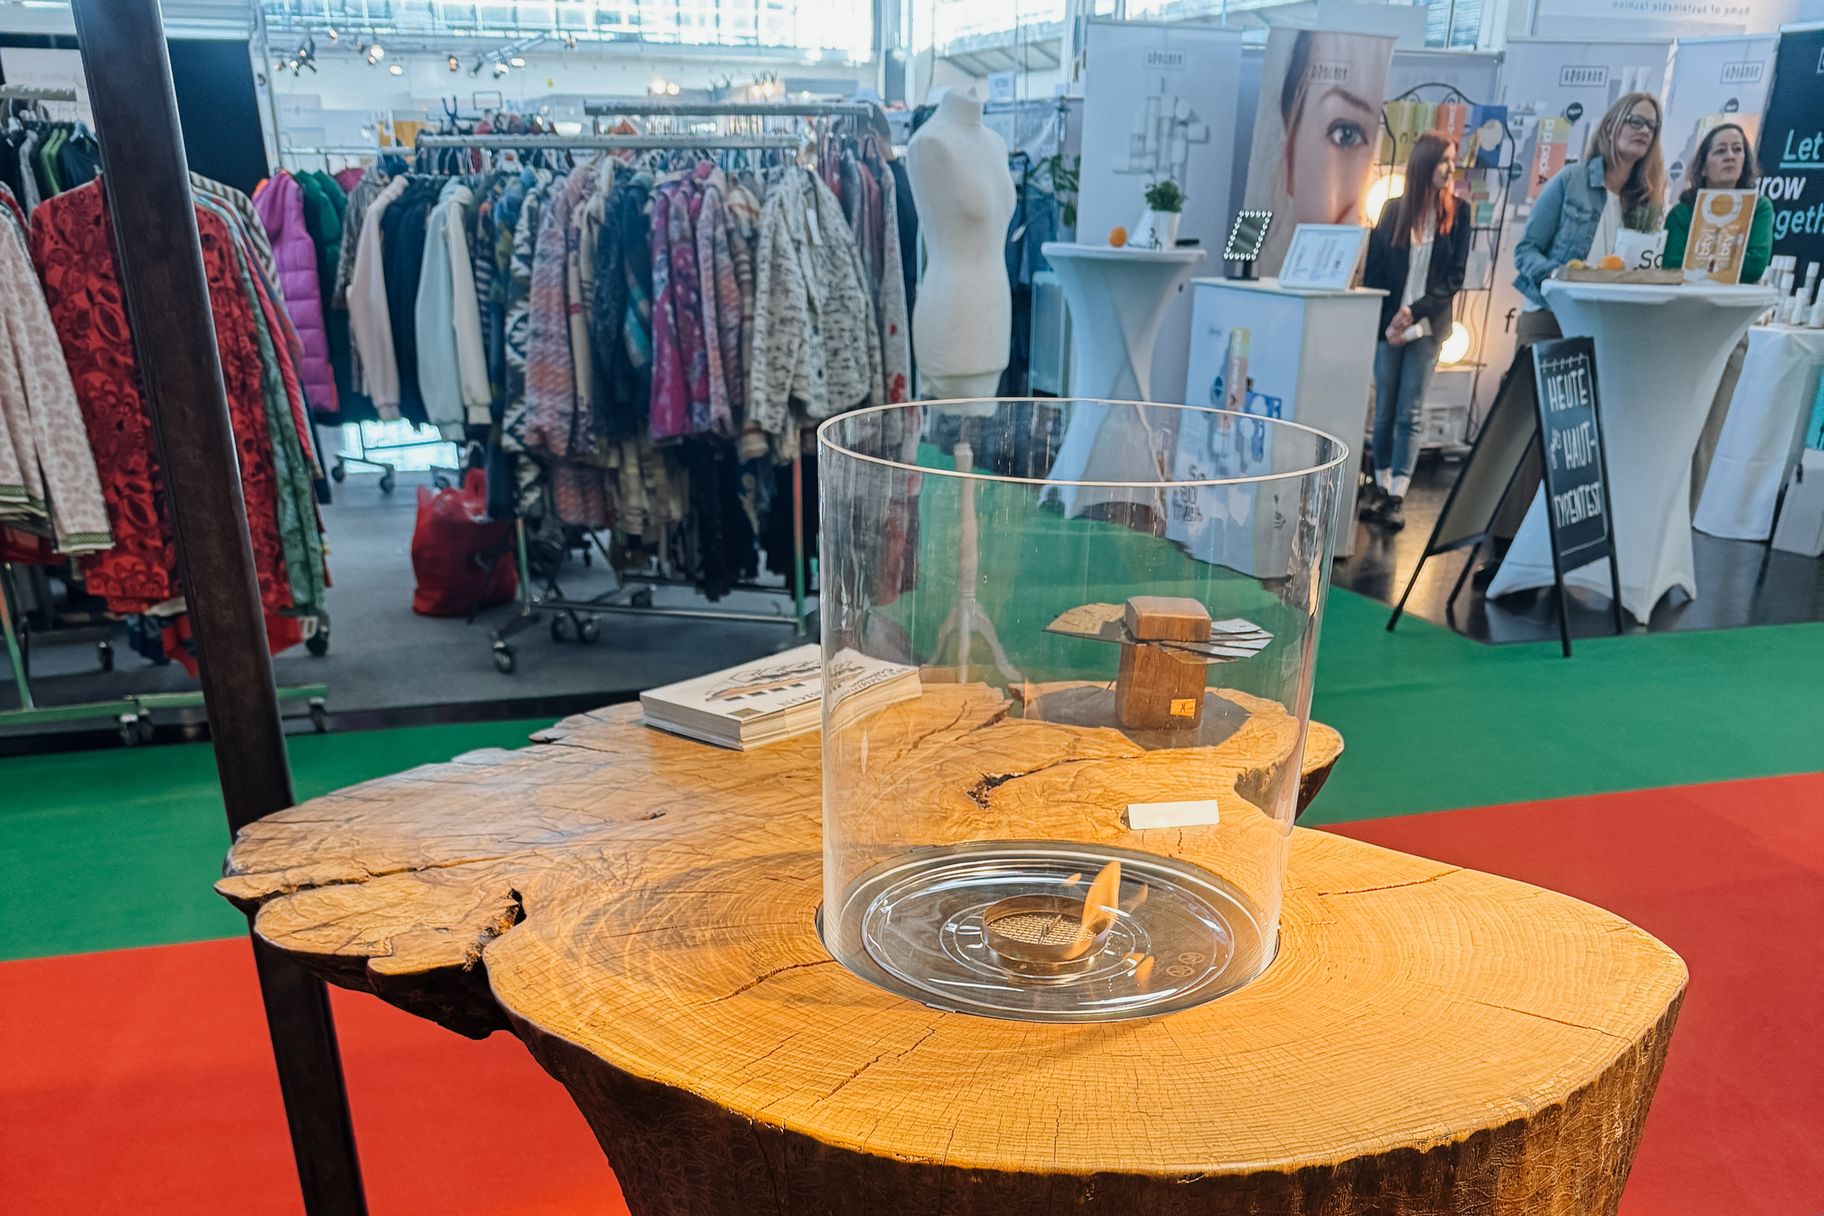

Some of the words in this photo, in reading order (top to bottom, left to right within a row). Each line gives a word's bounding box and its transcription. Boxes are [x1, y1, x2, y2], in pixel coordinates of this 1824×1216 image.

[1755, 176, 1807, 200] row
[1773, 203, 1824, 241] geth
[1547, 368, 1589, 412] HEUTE
[1563, 421, 1597, 470] HAUT-
[1553, 481, 1601, 529] TYPENTEST
